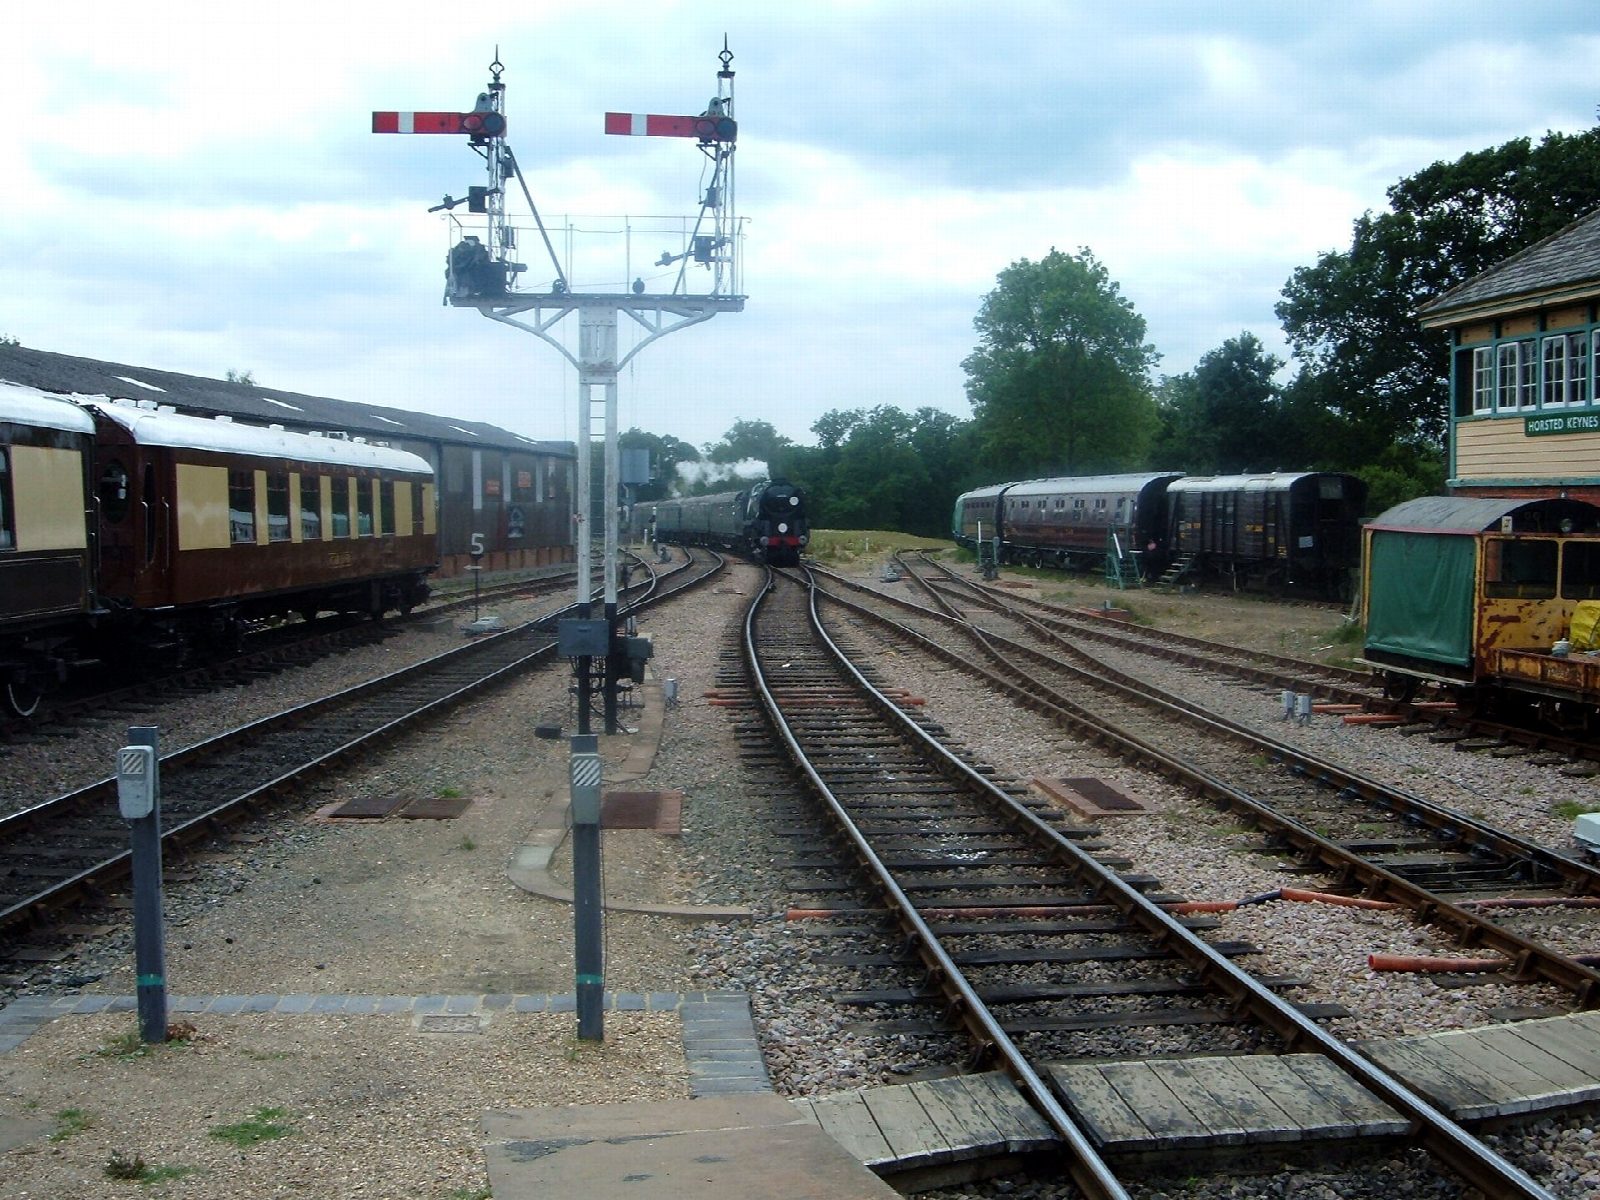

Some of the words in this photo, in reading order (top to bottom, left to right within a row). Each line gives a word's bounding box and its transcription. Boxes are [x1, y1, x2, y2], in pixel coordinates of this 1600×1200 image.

[1528, 418, 1564, 432] HORSTED
[1567, 416, 1599, 428] KEYNES
[471, 533, 484, 554] 5
